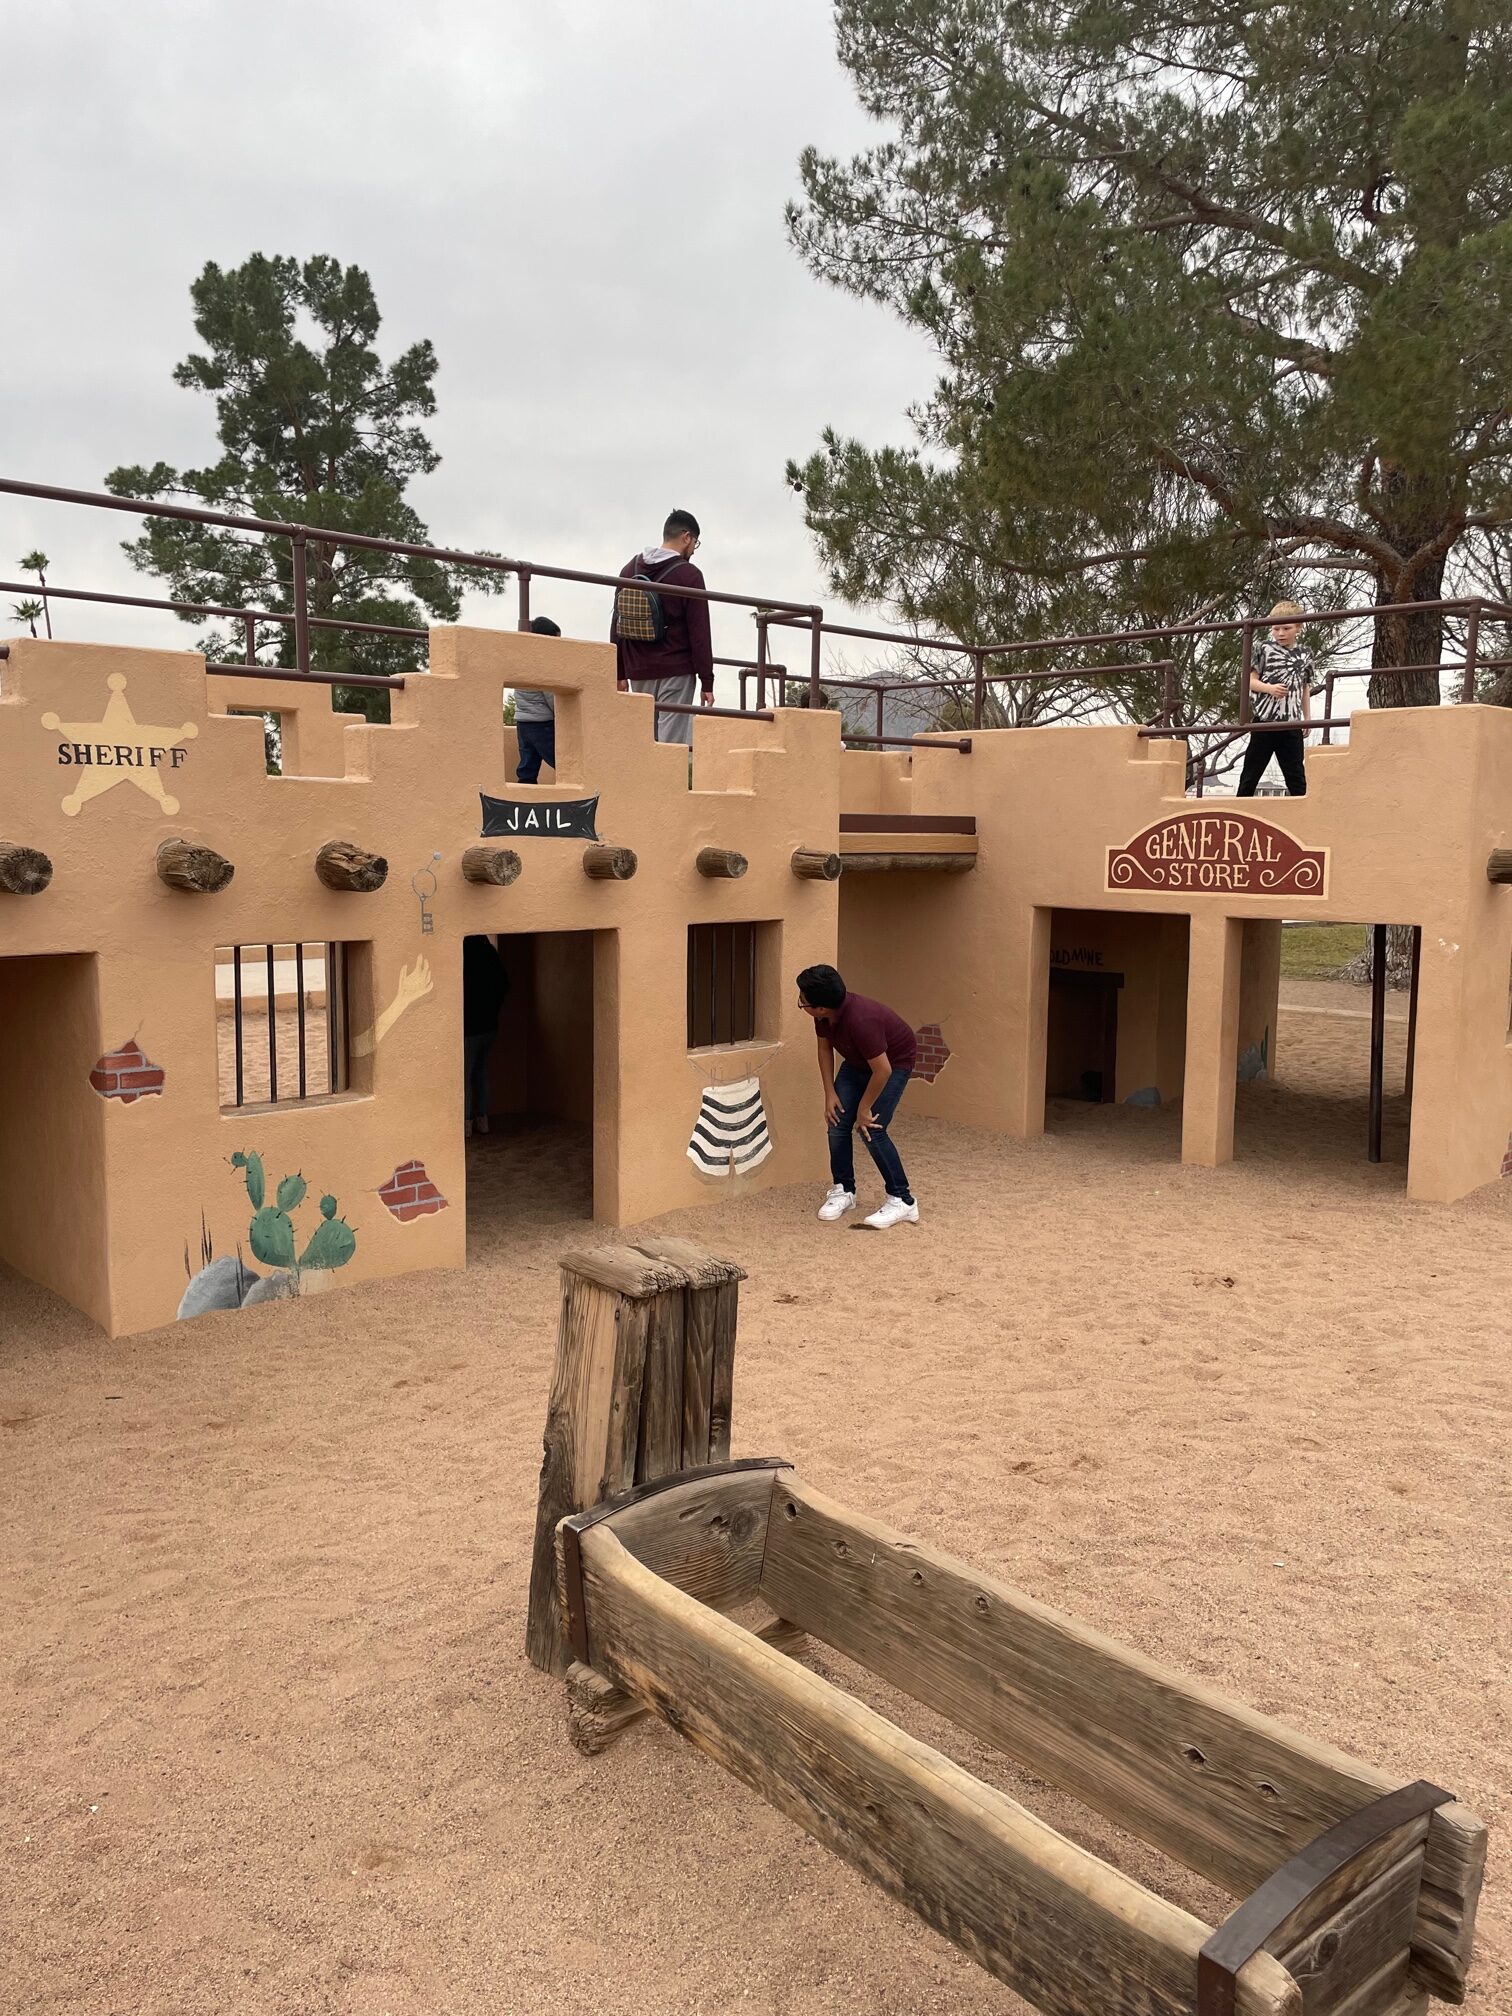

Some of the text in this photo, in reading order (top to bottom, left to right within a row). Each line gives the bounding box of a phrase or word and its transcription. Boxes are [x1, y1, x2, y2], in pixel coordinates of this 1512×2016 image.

[58, 743, 187, 768] SHERIFF
[507, 807, 571, 830] JAIL
[1145, 819, 1281, 863] GENERAL
[1169, 863, 1250, 889] STORE
